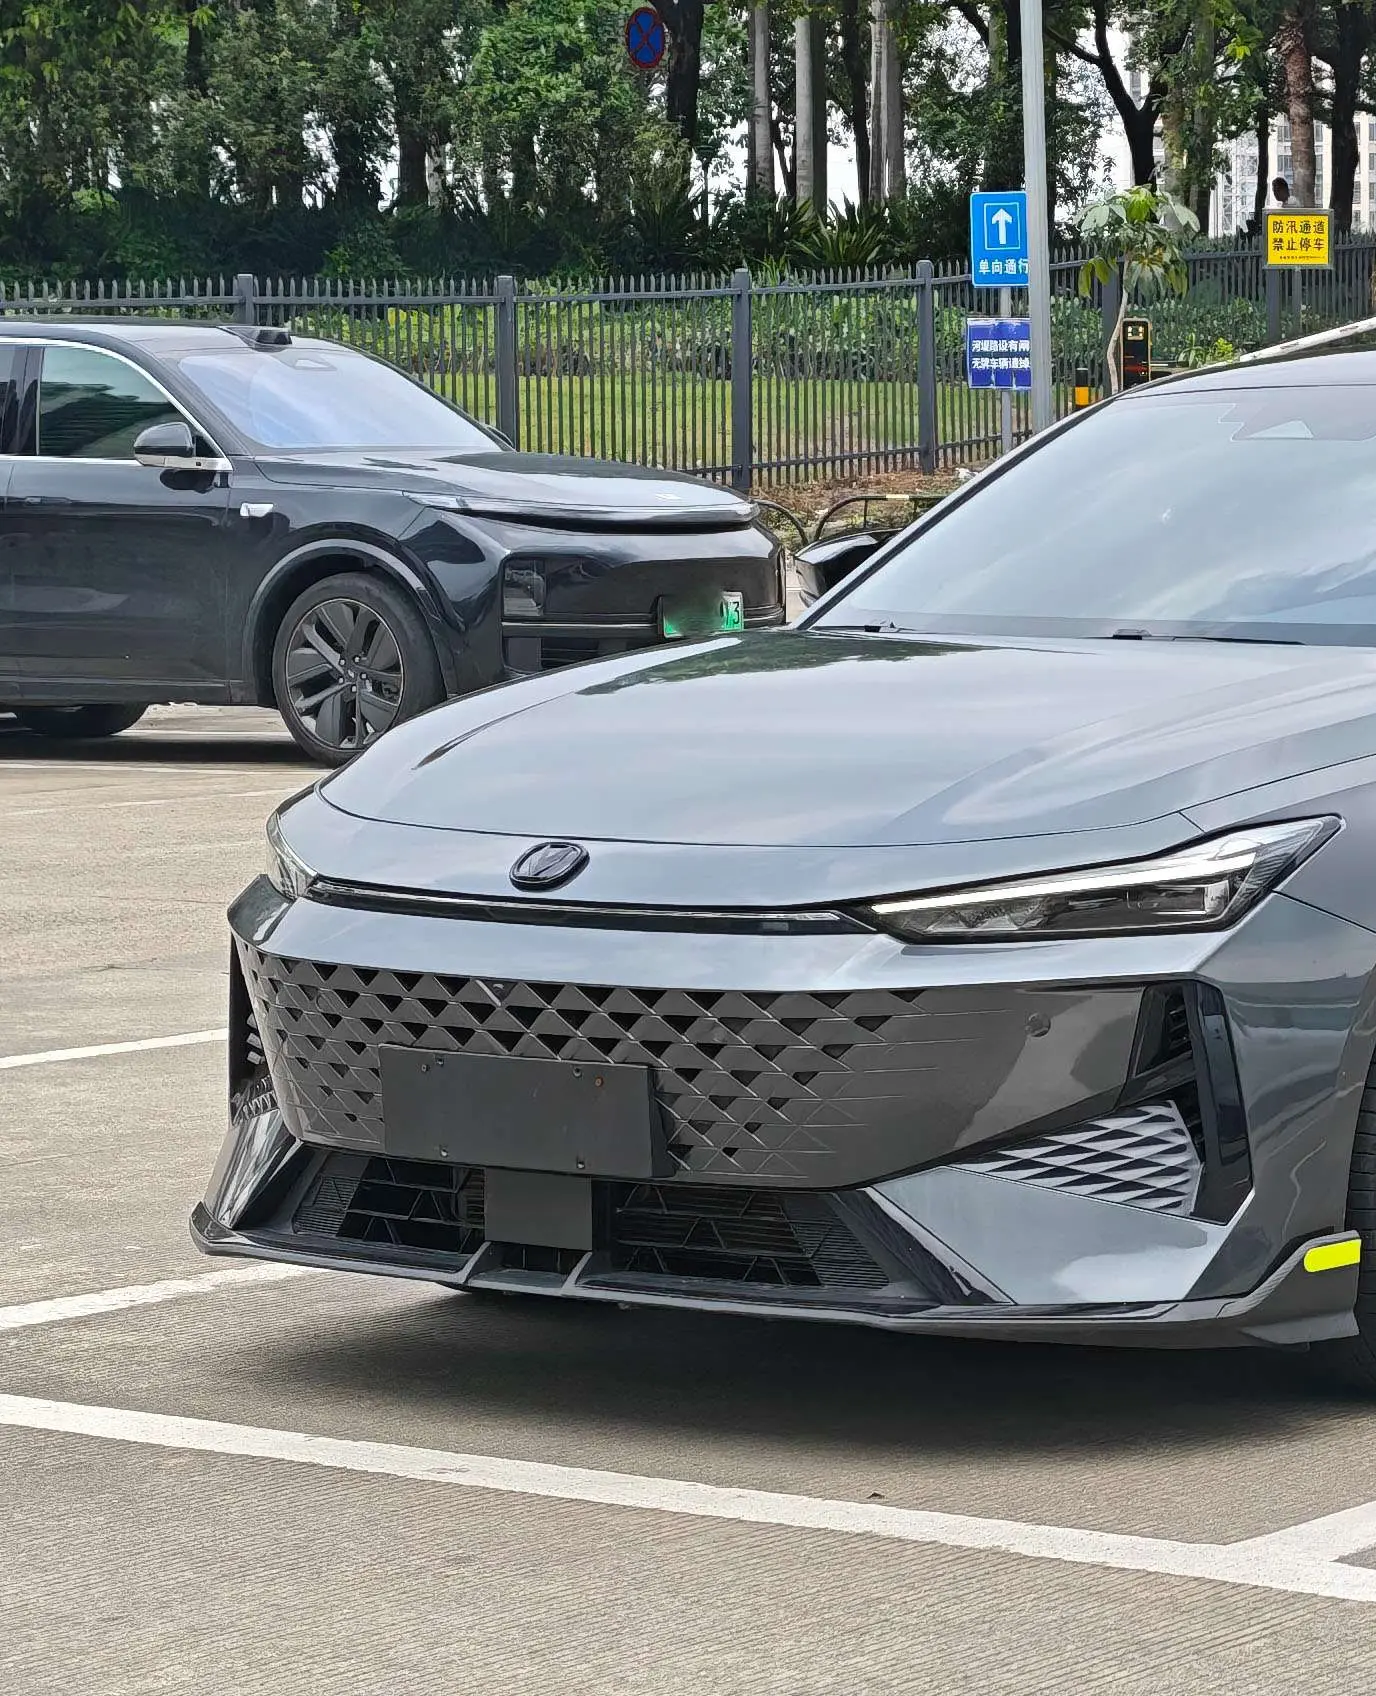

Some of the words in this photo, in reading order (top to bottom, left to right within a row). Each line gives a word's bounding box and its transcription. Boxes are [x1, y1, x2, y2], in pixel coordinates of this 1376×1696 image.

[1272, 220, 1325, 234] 防汛通道
[1272, 237, 1325, 251] 禁止停车
[978, 258, 1029, 275] 单向通行
